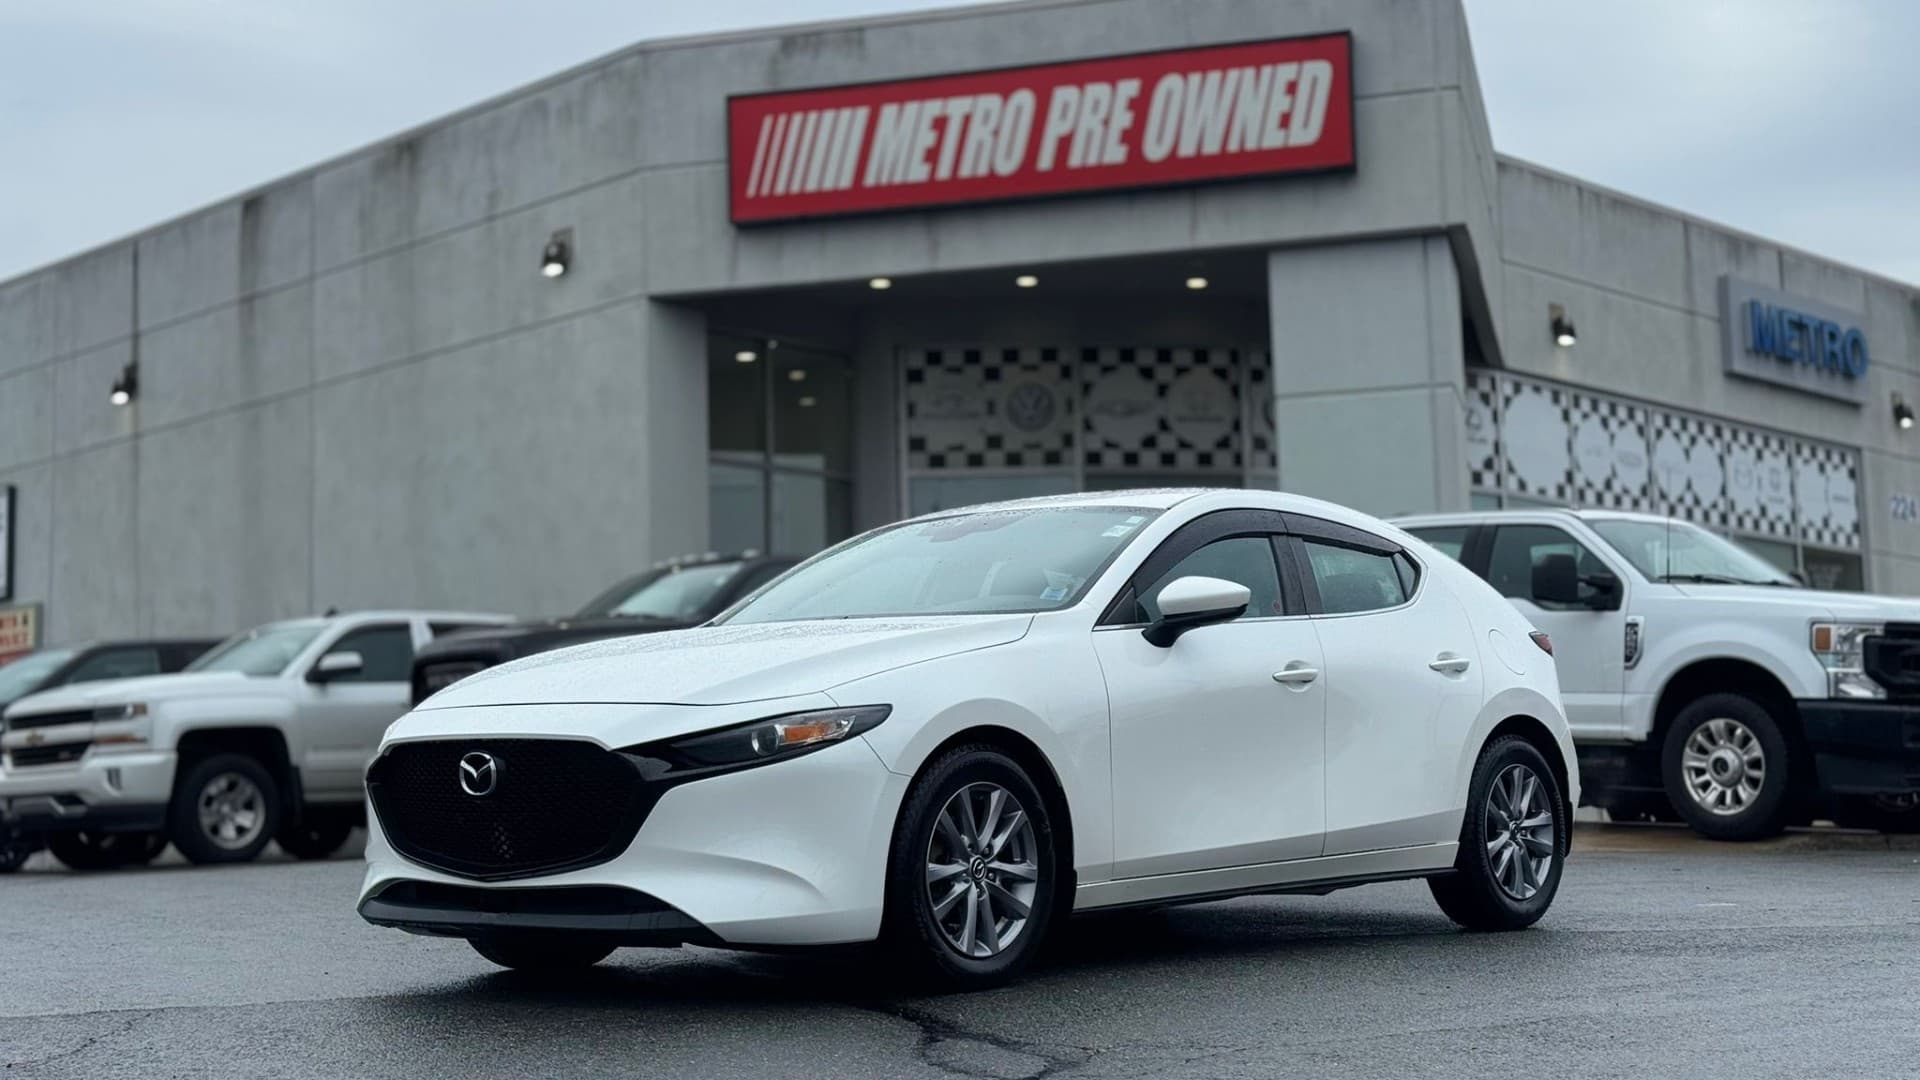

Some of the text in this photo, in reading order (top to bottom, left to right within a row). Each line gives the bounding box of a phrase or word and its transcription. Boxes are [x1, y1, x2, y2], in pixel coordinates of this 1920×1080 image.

[862, 58, 1334, 188] METRO PRE OWNED
[1744, 298, 1869, 379] METRO
